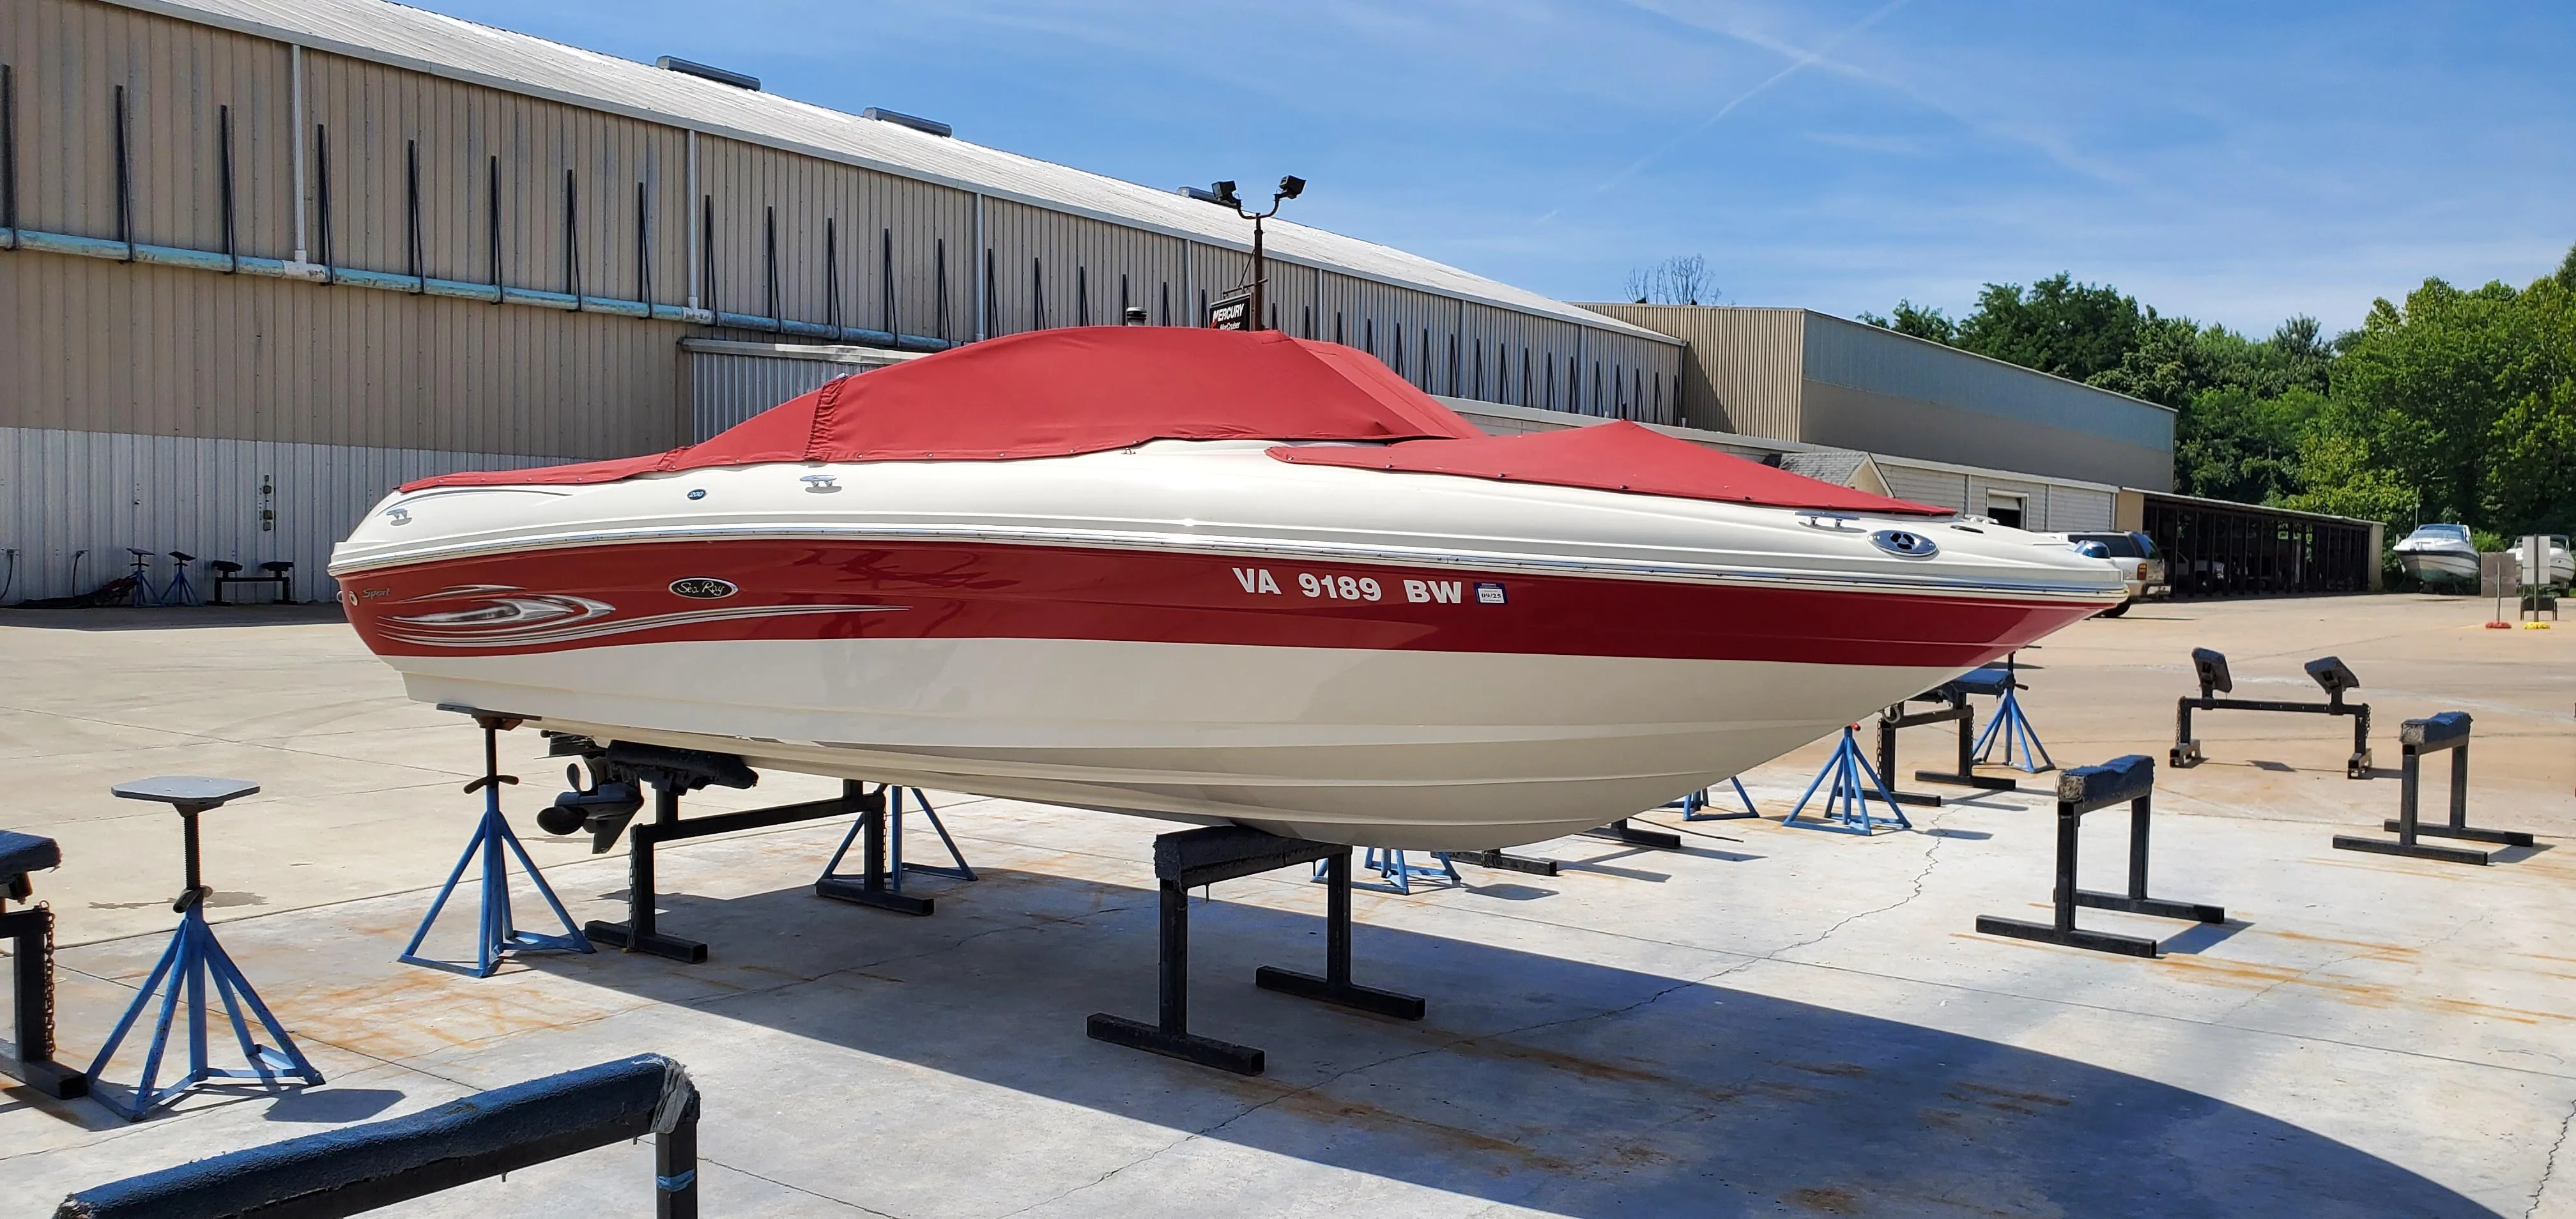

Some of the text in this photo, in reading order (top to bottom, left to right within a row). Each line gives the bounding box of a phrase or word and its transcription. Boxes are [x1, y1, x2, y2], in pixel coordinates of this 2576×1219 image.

[1213, 303, 1245, 322] MERCURY
[1220, 321, 1241, 330] MerCruiser
[677, 581, 724, 596] Sea Ray
[1232, 567, 1462, 604] VA 9189 BW
[362, 588, 391, 600] Sport
